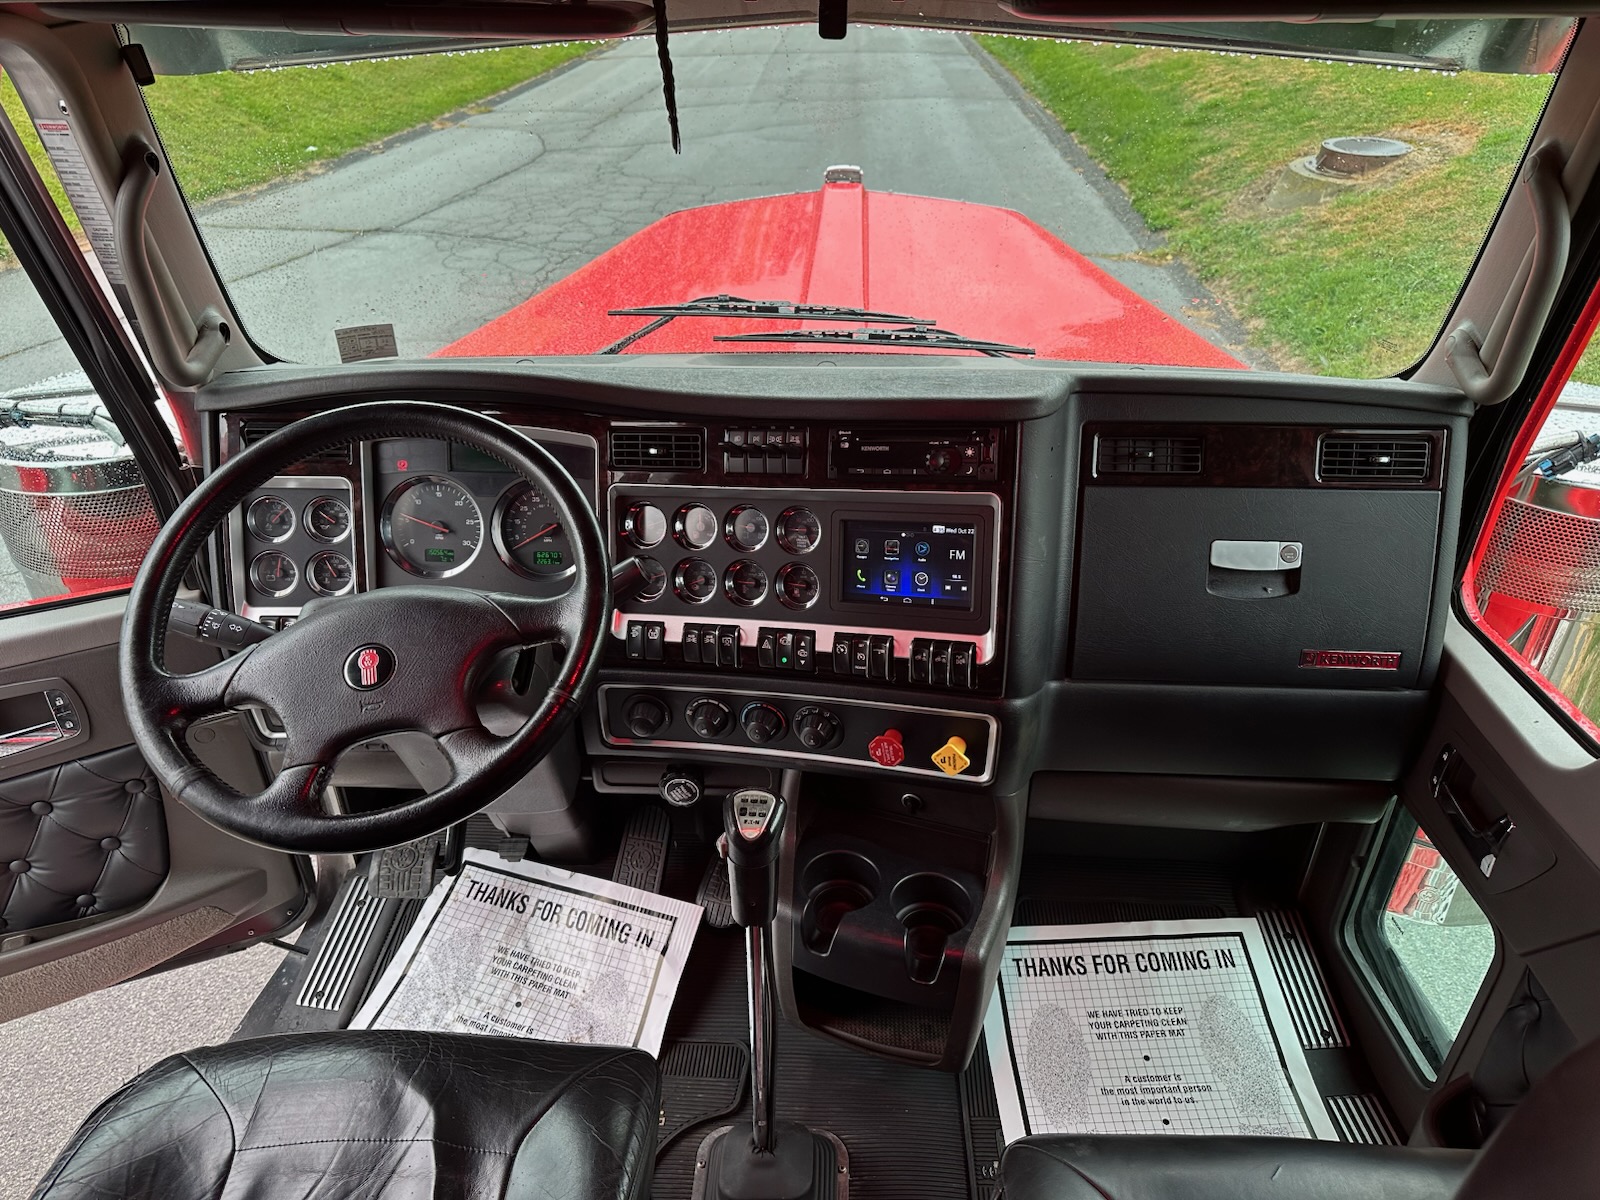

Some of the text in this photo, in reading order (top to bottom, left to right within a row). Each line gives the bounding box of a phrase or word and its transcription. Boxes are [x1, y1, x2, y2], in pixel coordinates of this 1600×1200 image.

[950, 550, 966, 560] FM
[1321, 654, 1397, 666] KENWORTH
[466, 880, 655, 948] THANKS FOR COMING IN
[498, 946, 581, 977] WE HAVE TRIED TO KEEP
[1012, 948, 1236, 978] THANKS FOR COMING IN
[492, 956, 578, 990] YOUR CARPETING CLEAN
[491, 967, 570, 999] WITH THIS PAPER MAT
[1087, 1010, 1100, 1019] WE
[1102, 1010, 1123, 1018] HAVE
[1125, 1008, 1149, 1017] TRIED
[1163, 1007, 1183, 1015] KEEP
[456, 1015, 468, 1026] the
[469, 1019, 488, 1032] most
[491, 1016, 525, 1031] customer
[526, 1026, 534, 1035] is
[1088, 1017, 1187, 1030] YOUR CARPETING CLEAN
[1096, 1028, 1185, 1040] WITH THIS PAPER MAT
[1133, 1074, 1171, 1083] customer
[1174, 1073, 1182, 1081] is
[1100, 1085, 1212, 1096] the most important person
[1132, 1098, 1146, 1106] the
[1148, 1096, 1172, 1105] world
